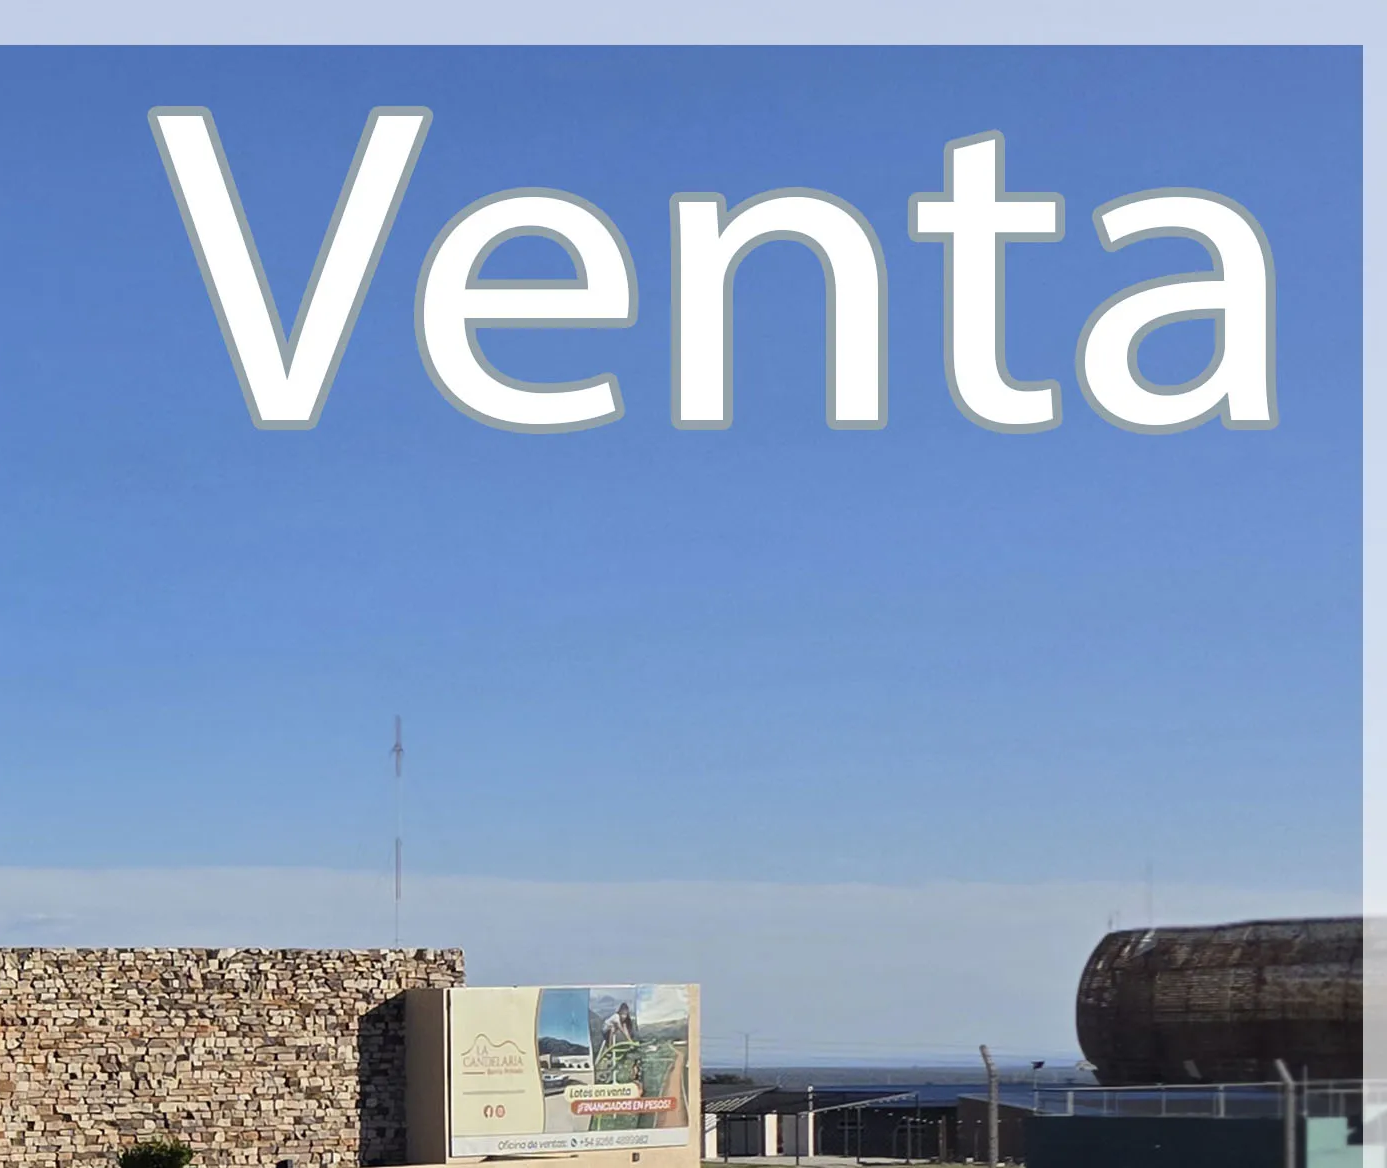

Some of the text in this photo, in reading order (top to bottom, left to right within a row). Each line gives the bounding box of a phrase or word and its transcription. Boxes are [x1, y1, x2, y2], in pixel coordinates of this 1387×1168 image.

[569, 1086, 631, 1099] Lotes en venta
[632, 1100, 644, 1112] EN
[498, 1138, 526, 1151] Oficina
[528, 1139, 538, 1149] de
